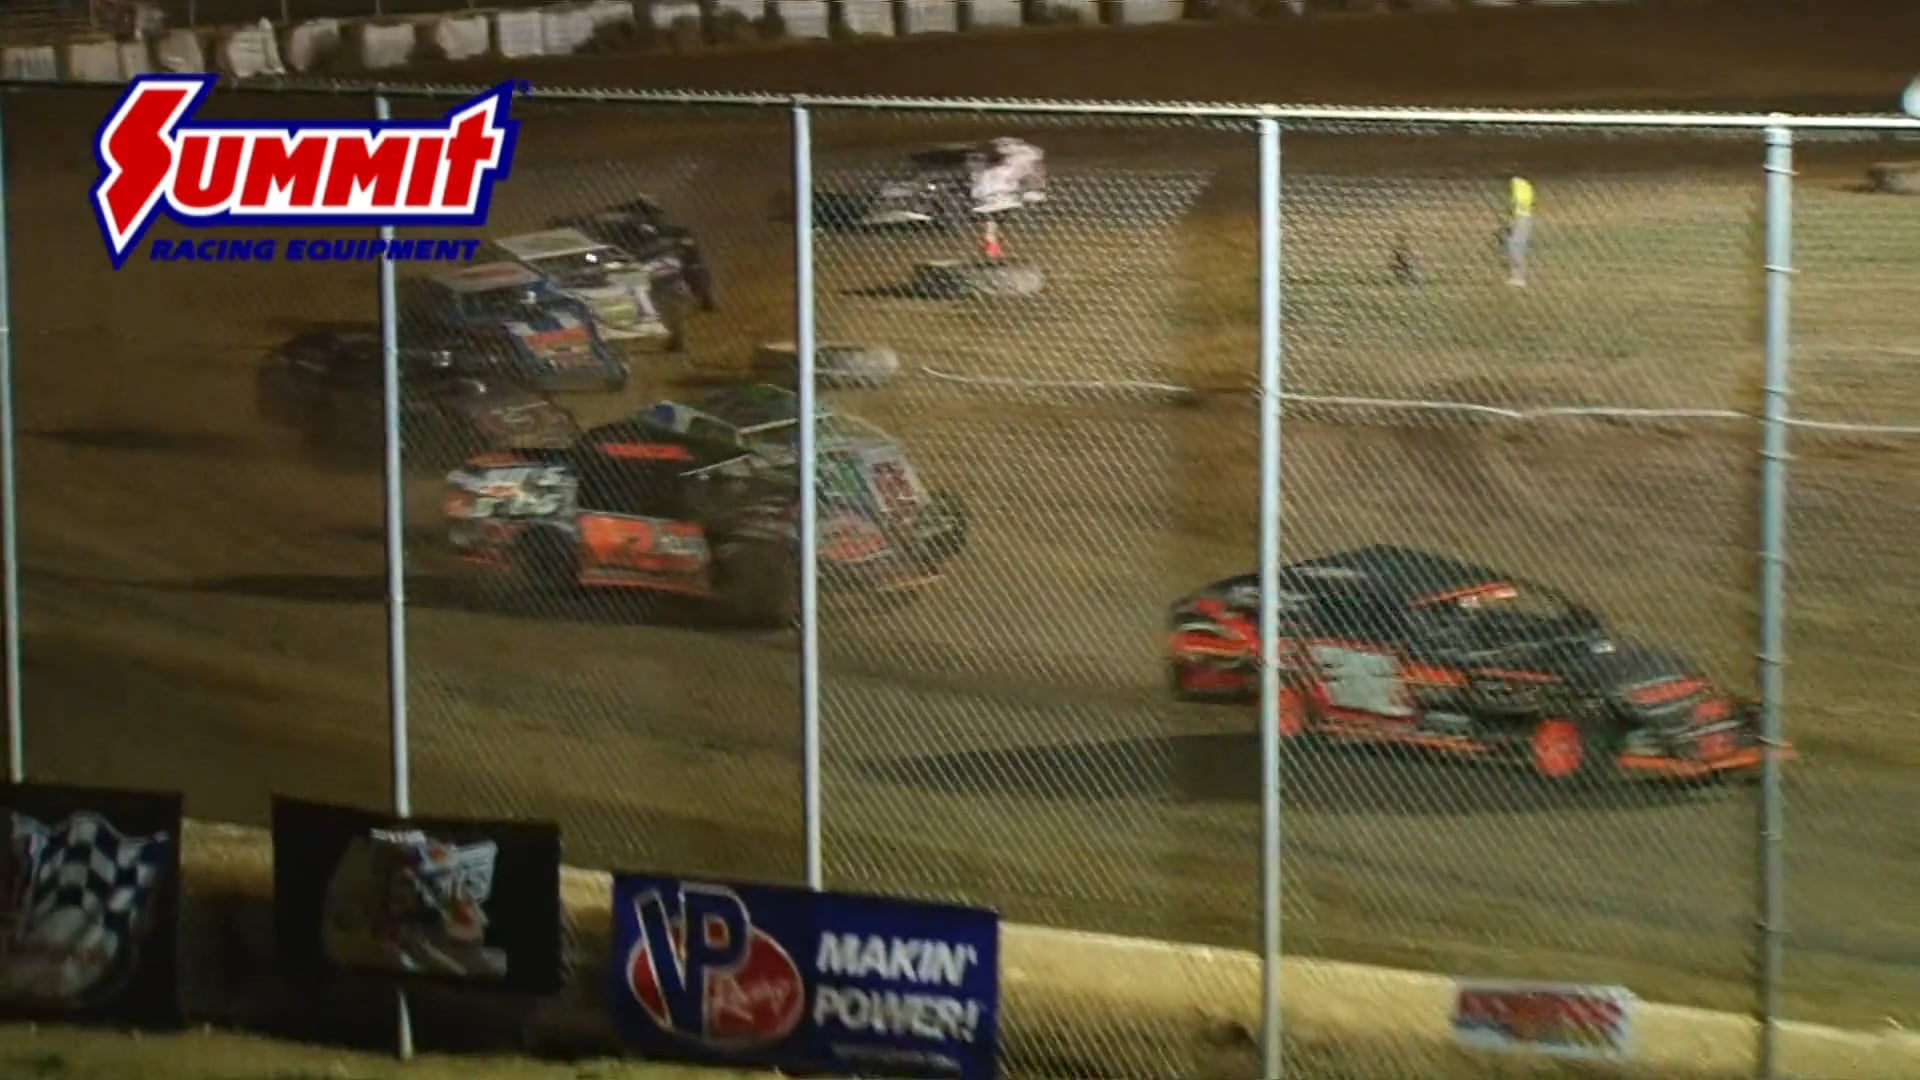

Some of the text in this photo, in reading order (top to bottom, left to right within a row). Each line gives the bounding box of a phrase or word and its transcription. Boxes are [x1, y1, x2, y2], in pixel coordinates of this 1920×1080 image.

[632, 880, 752, 1042] VP
[816, 930, 978, 987] MAKIN'
[813, 983, 981, 1044] POWER!
